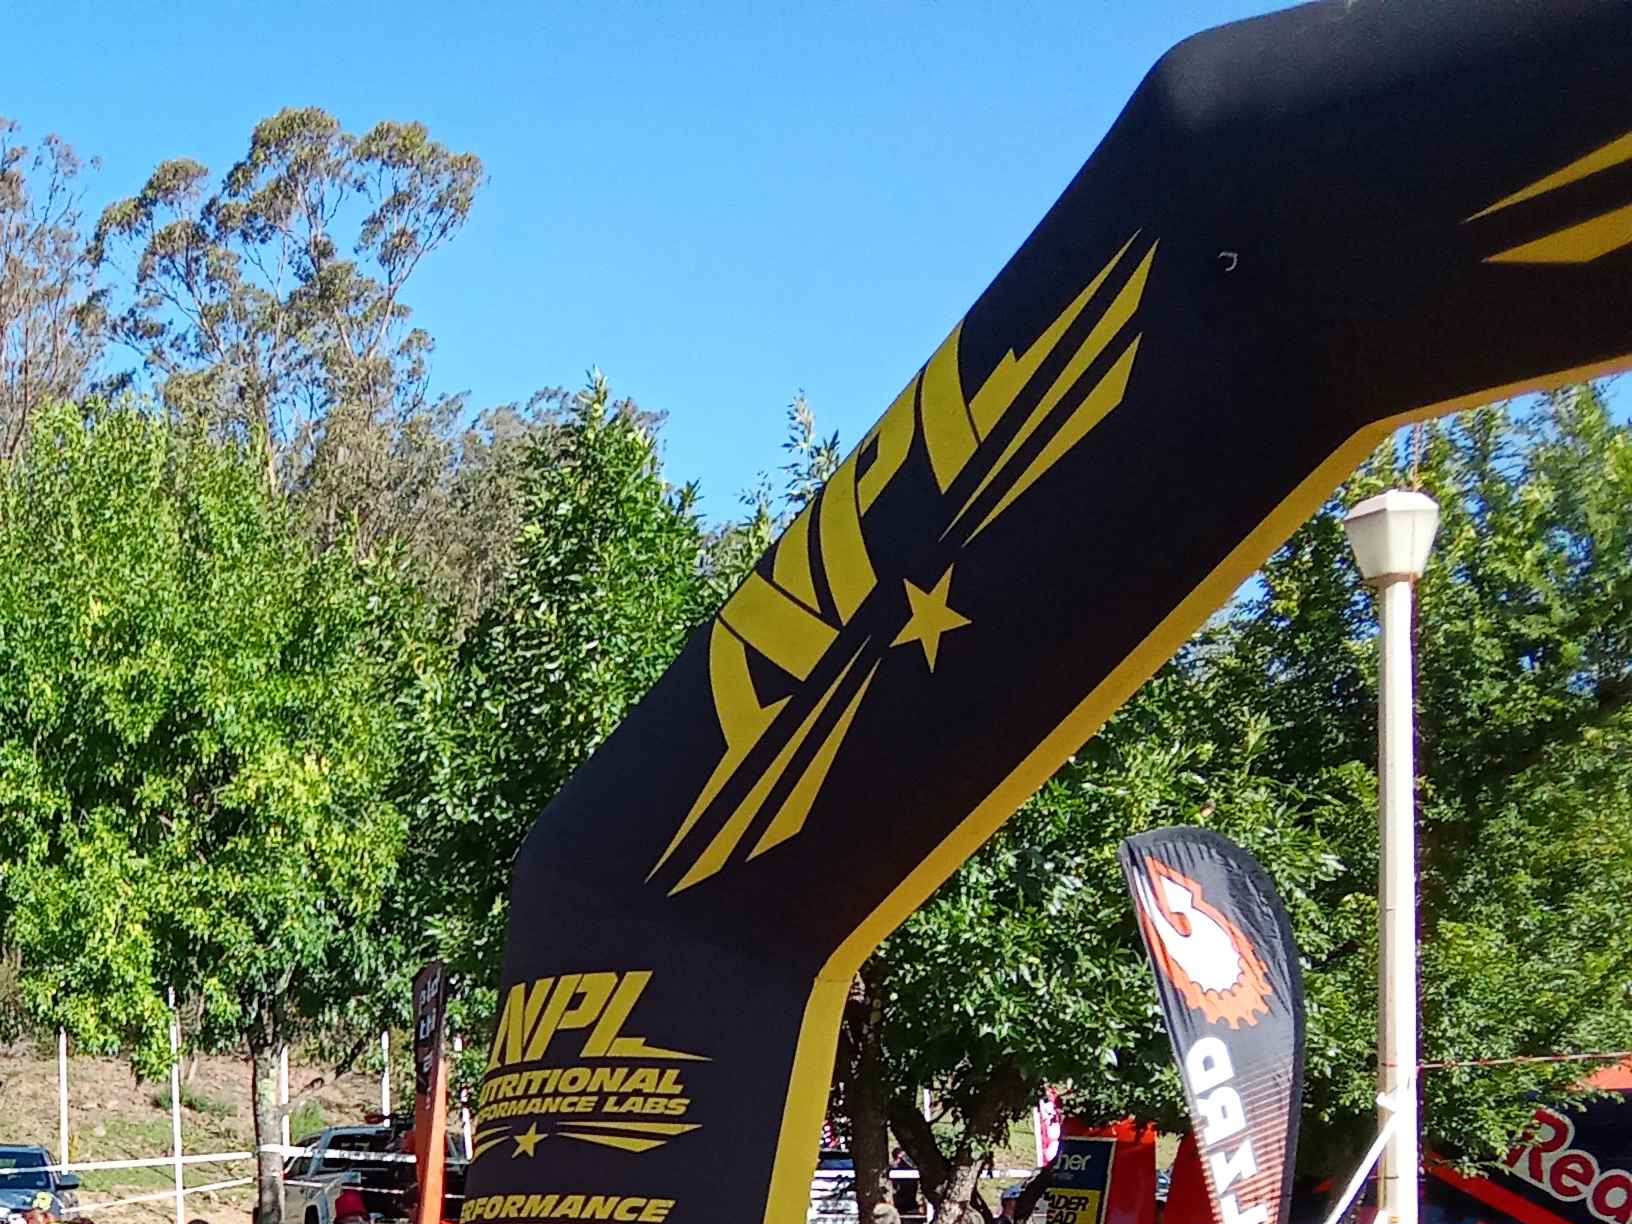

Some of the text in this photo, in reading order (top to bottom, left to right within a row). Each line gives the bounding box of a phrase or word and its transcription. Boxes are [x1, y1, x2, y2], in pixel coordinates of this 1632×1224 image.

[658, 255, 1093, 835] NPL
[484, 970, 712, 1073] NPL
[480, 1067, 684, 1107] UTRITIONAL
[480, 1096, 690, 1123] FORMANCE LABS
[460, 1194, 675, 1223] RFORMANCE
